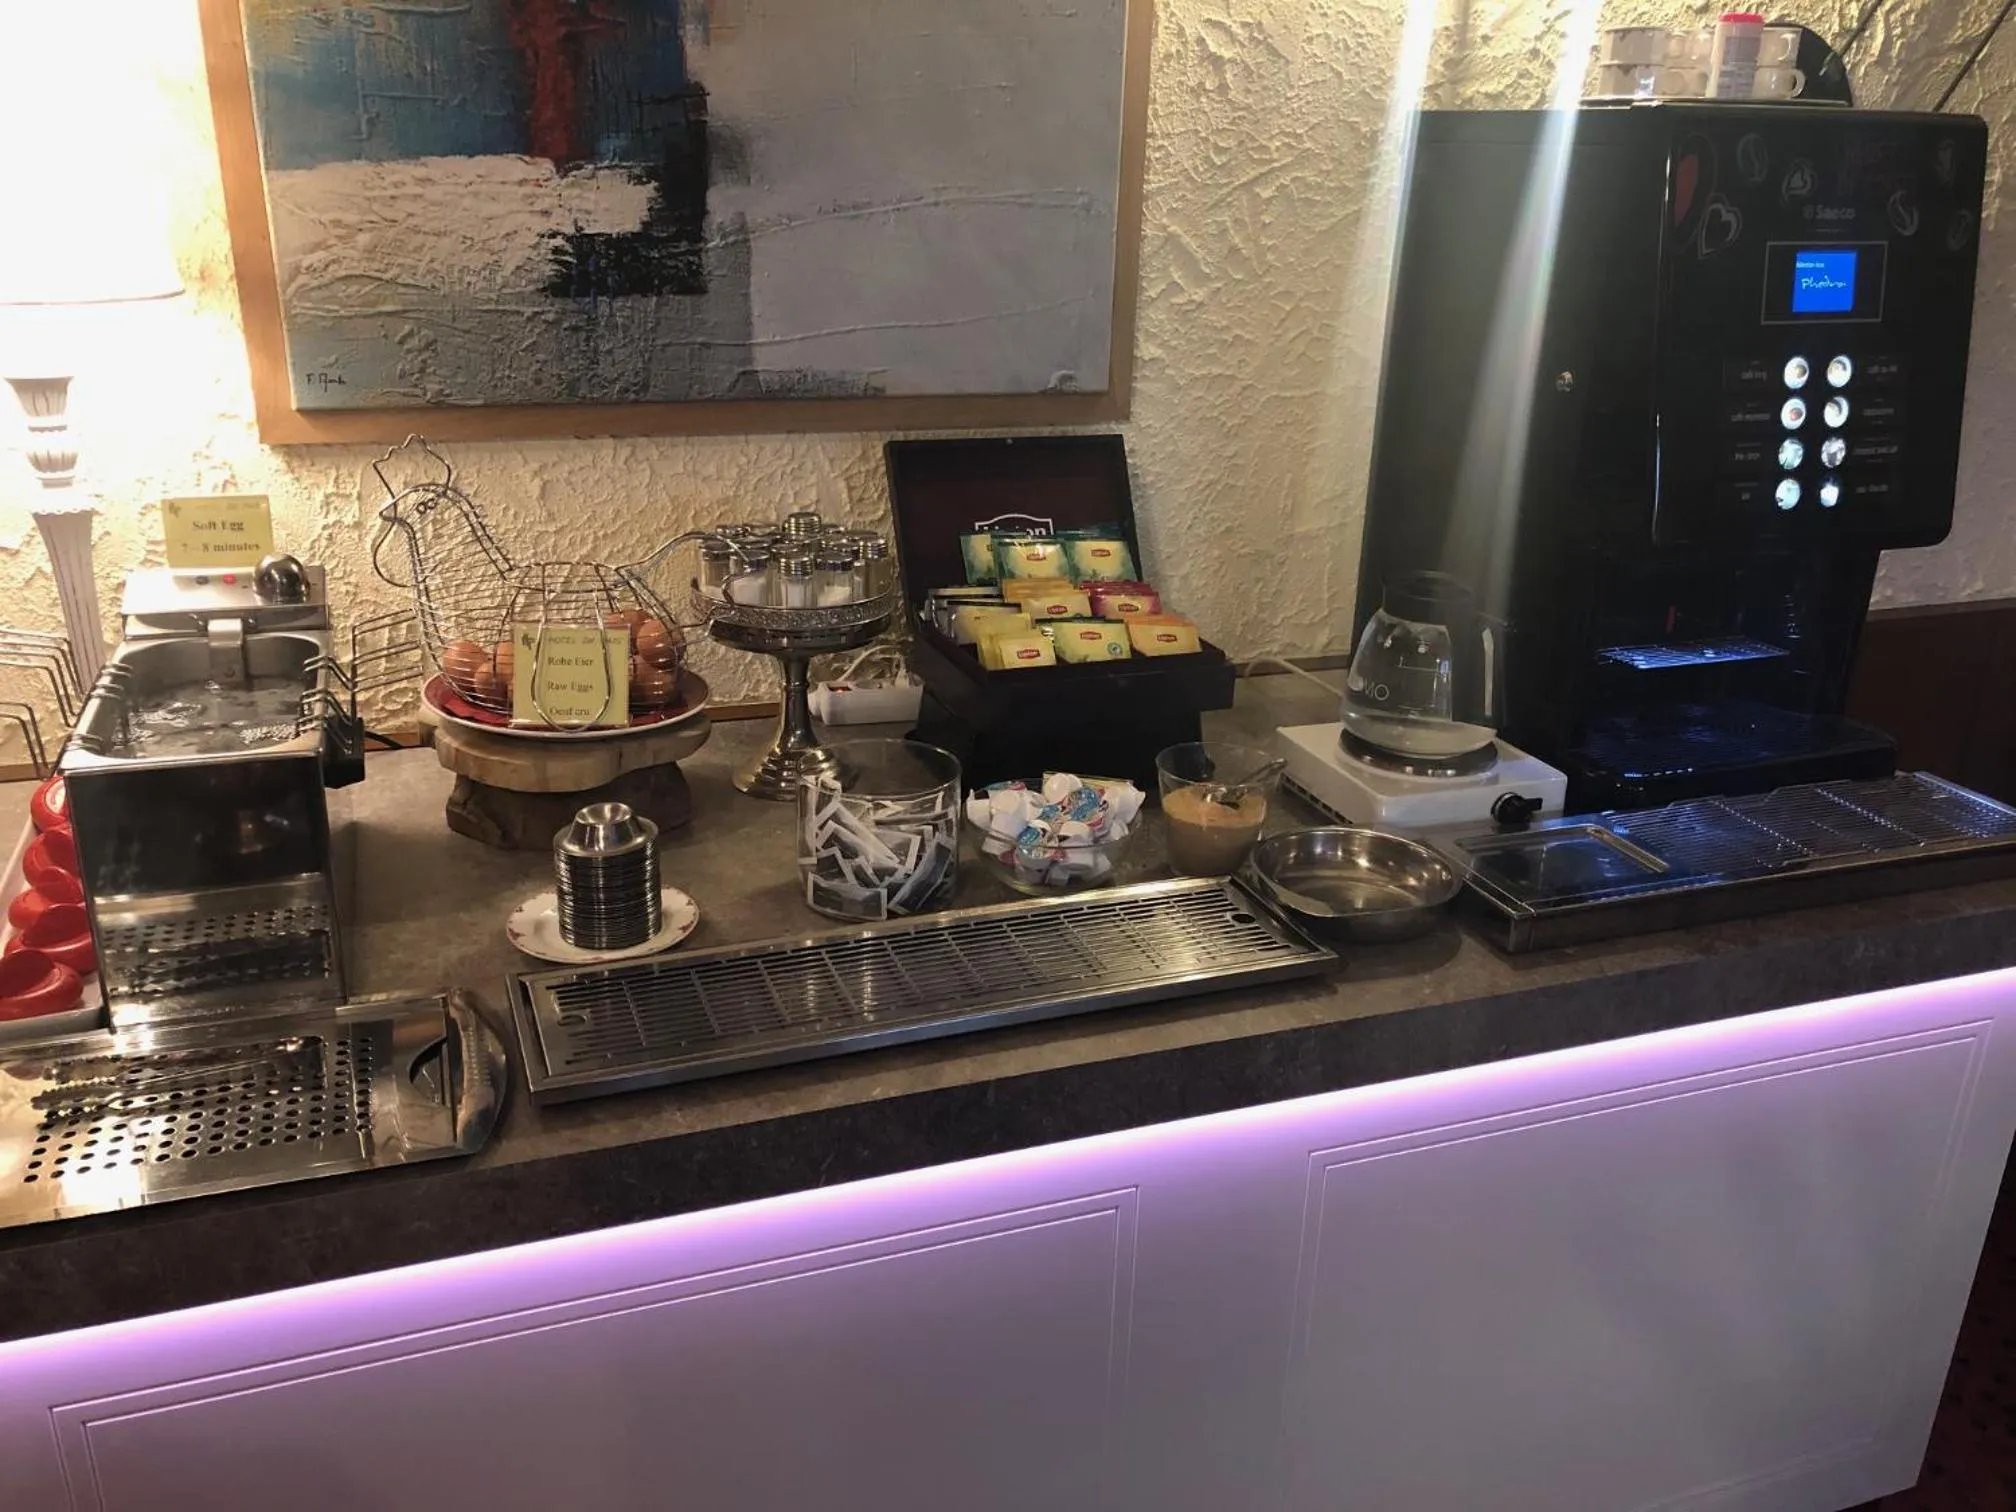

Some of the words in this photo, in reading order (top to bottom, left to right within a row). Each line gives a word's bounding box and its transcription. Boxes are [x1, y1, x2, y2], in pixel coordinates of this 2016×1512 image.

[1816, 203, 1856, 220] Saeco
[192, 520, 217, 532] Soft
[220, 520, 245, 532] Egg
[202, 542, 210, 553] 8
[213, 542, 262, 553] minutes
[547, 680, 569, 691] Raw
